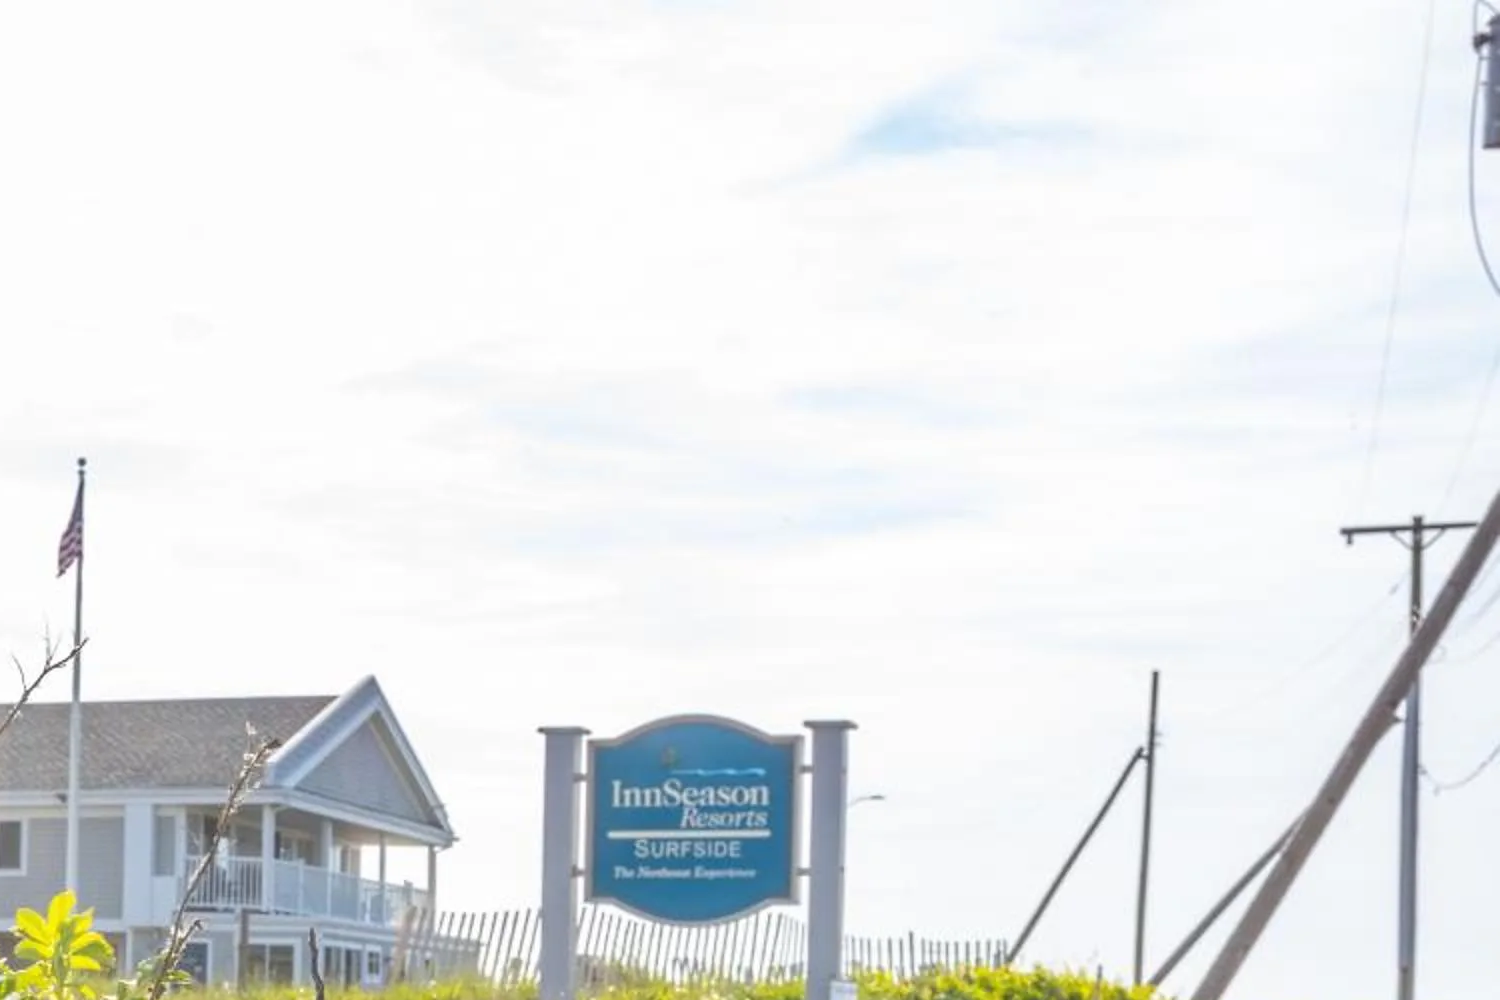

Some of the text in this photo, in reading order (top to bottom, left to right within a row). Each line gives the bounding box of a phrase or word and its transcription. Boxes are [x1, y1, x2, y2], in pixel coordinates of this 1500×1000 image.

[611, 778, 770, 808] InnSeason
[680, 807, 768, 829] Resorts
[634, 839, 742, 859] SURFSIDE
[614, 865, 635, 880] The
